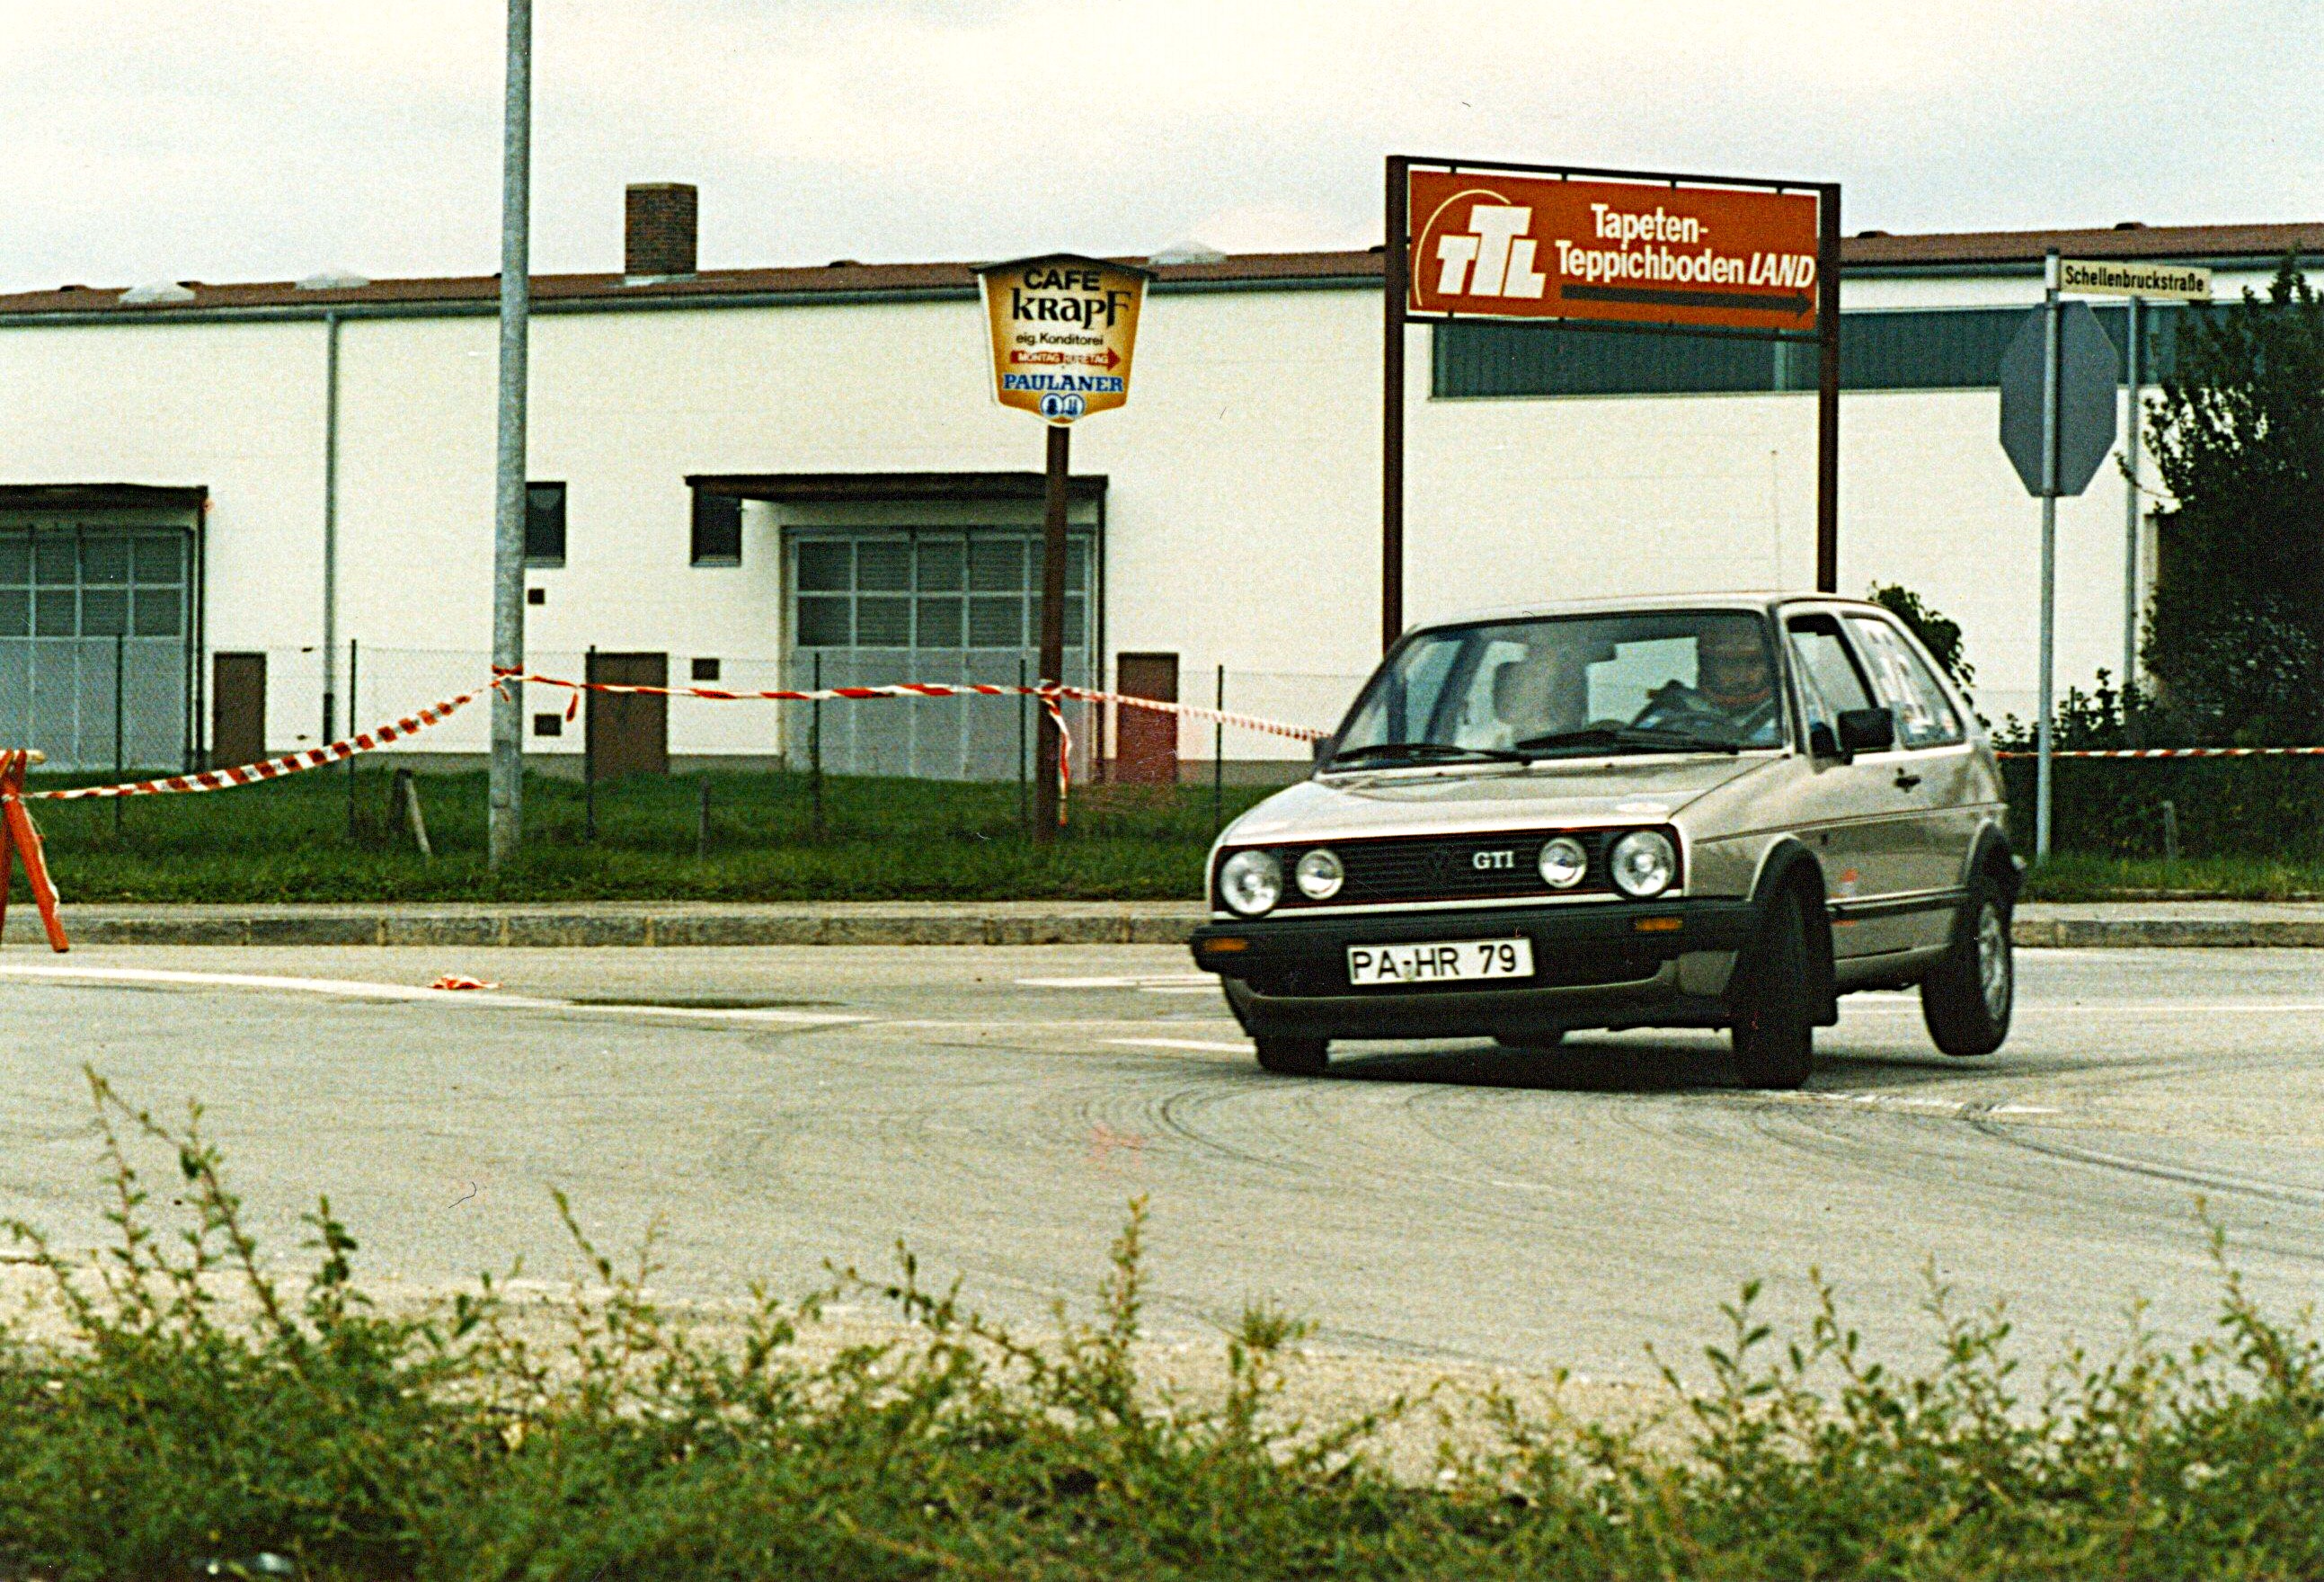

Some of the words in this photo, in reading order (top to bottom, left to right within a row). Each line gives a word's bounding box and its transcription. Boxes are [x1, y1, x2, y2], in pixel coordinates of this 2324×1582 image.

[1590, 203, 1709, 252] Tapeten-
[1556, 239, 1744, 284] Teppichboden
[1748, 253, 1816, 289] LAND
[1024, 269, 1101, 291] CAFE
[2065, 265, 2204, 292] Schellenbruckstraße
[1016, 333, 1038, 346] eig.
[1040, 333, 1104, 346] Konditorei
[1003, 374, 1123, 392] PAULANER
[1473, 851, 1515, 870] GTI
[1478, 944, 1517, 974] 79
